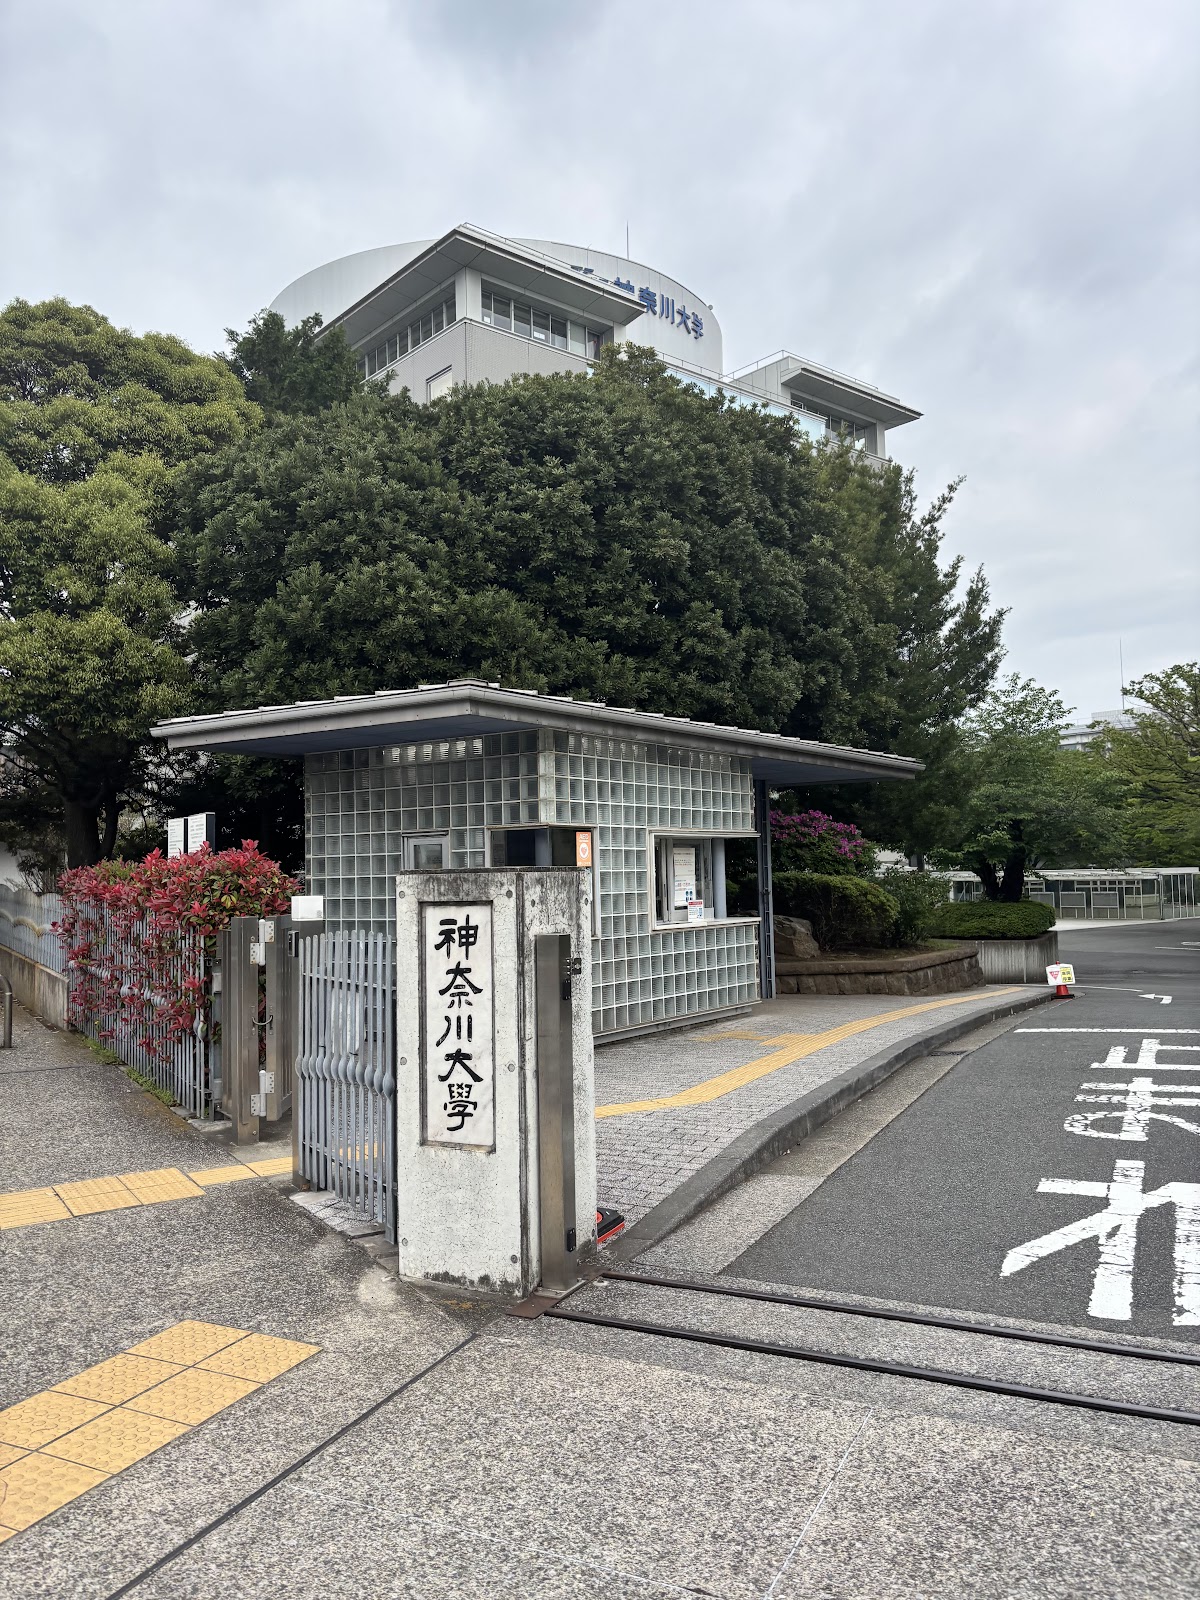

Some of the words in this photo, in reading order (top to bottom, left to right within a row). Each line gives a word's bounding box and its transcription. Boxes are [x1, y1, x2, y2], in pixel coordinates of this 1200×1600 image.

[435, 913, 484, 1131] 神奈川大學
